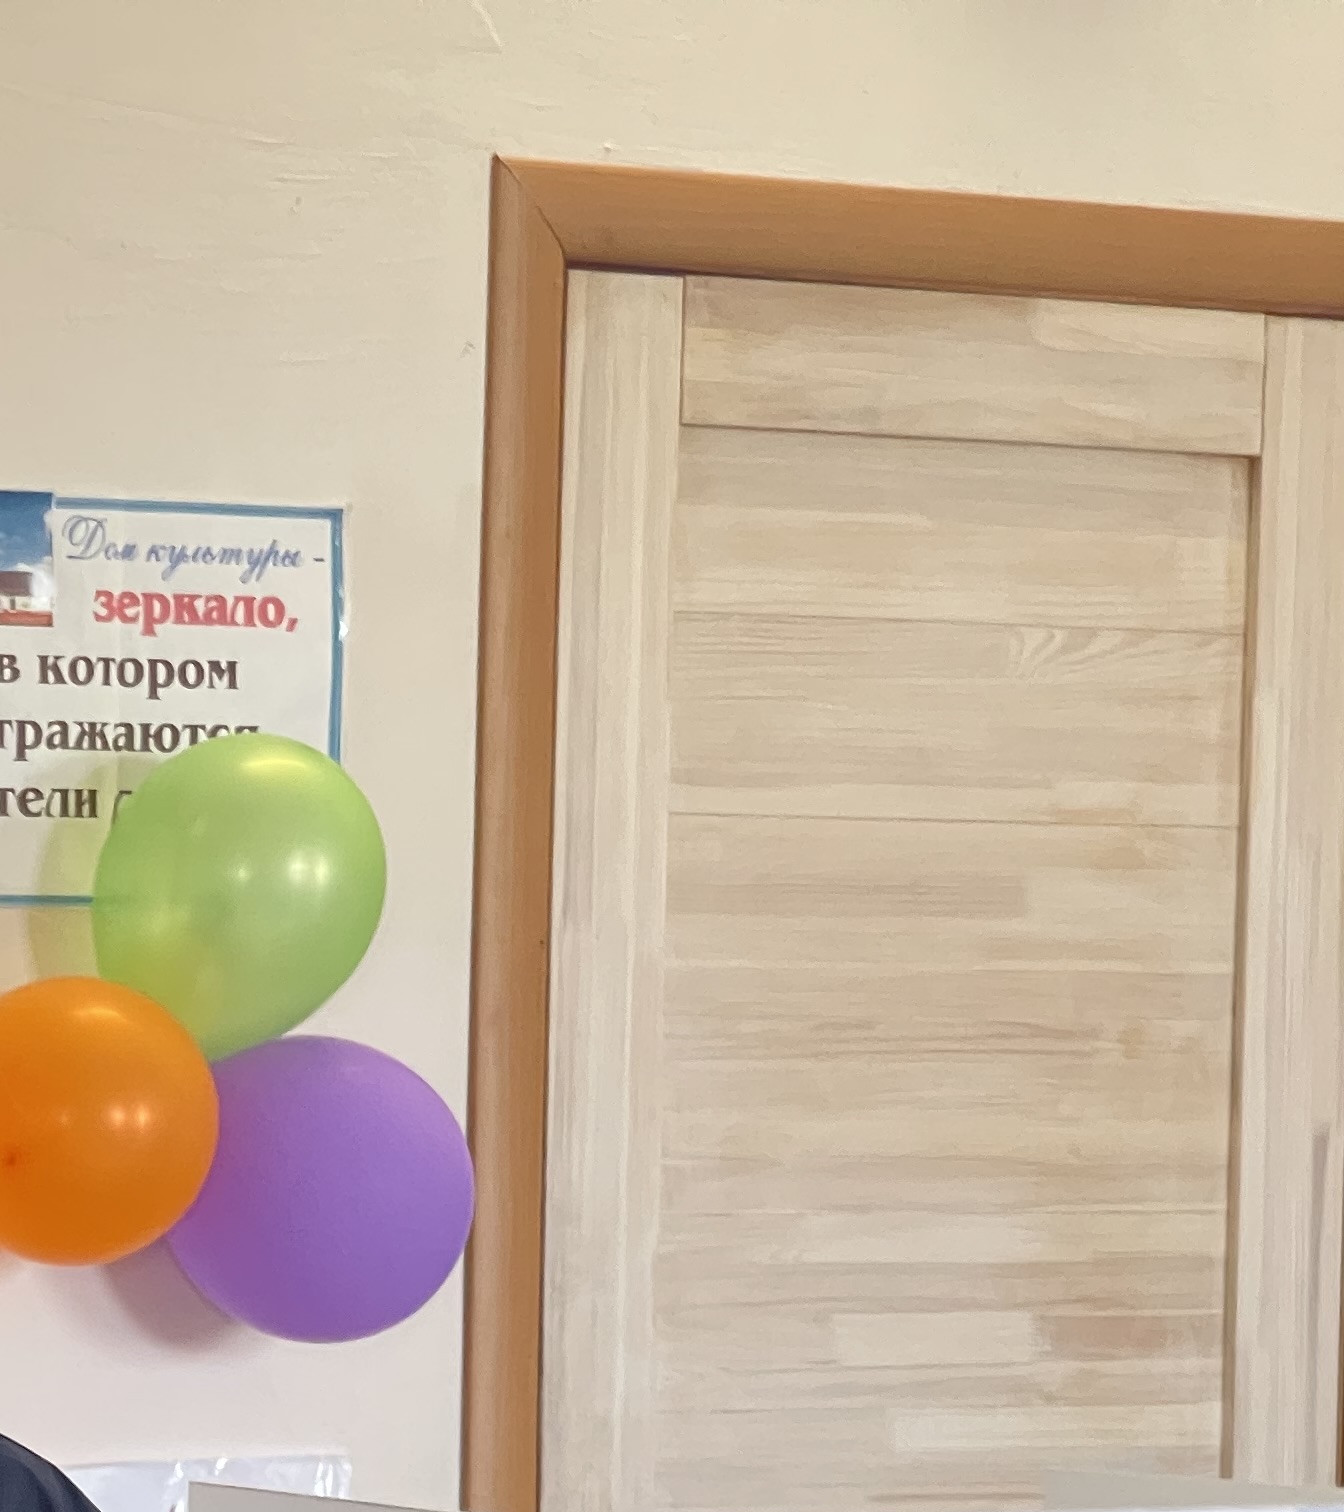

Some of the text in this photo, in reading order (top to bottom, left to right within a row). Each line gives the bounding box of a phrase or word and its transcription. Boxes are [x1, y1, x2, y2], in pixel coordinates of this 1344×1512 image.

[62, 514, 137, 561] Дом
[145, 539, 303, 585] культуры
[93, 589, 299, 637] зеркало,
[38, 654, 239, 700] котором
